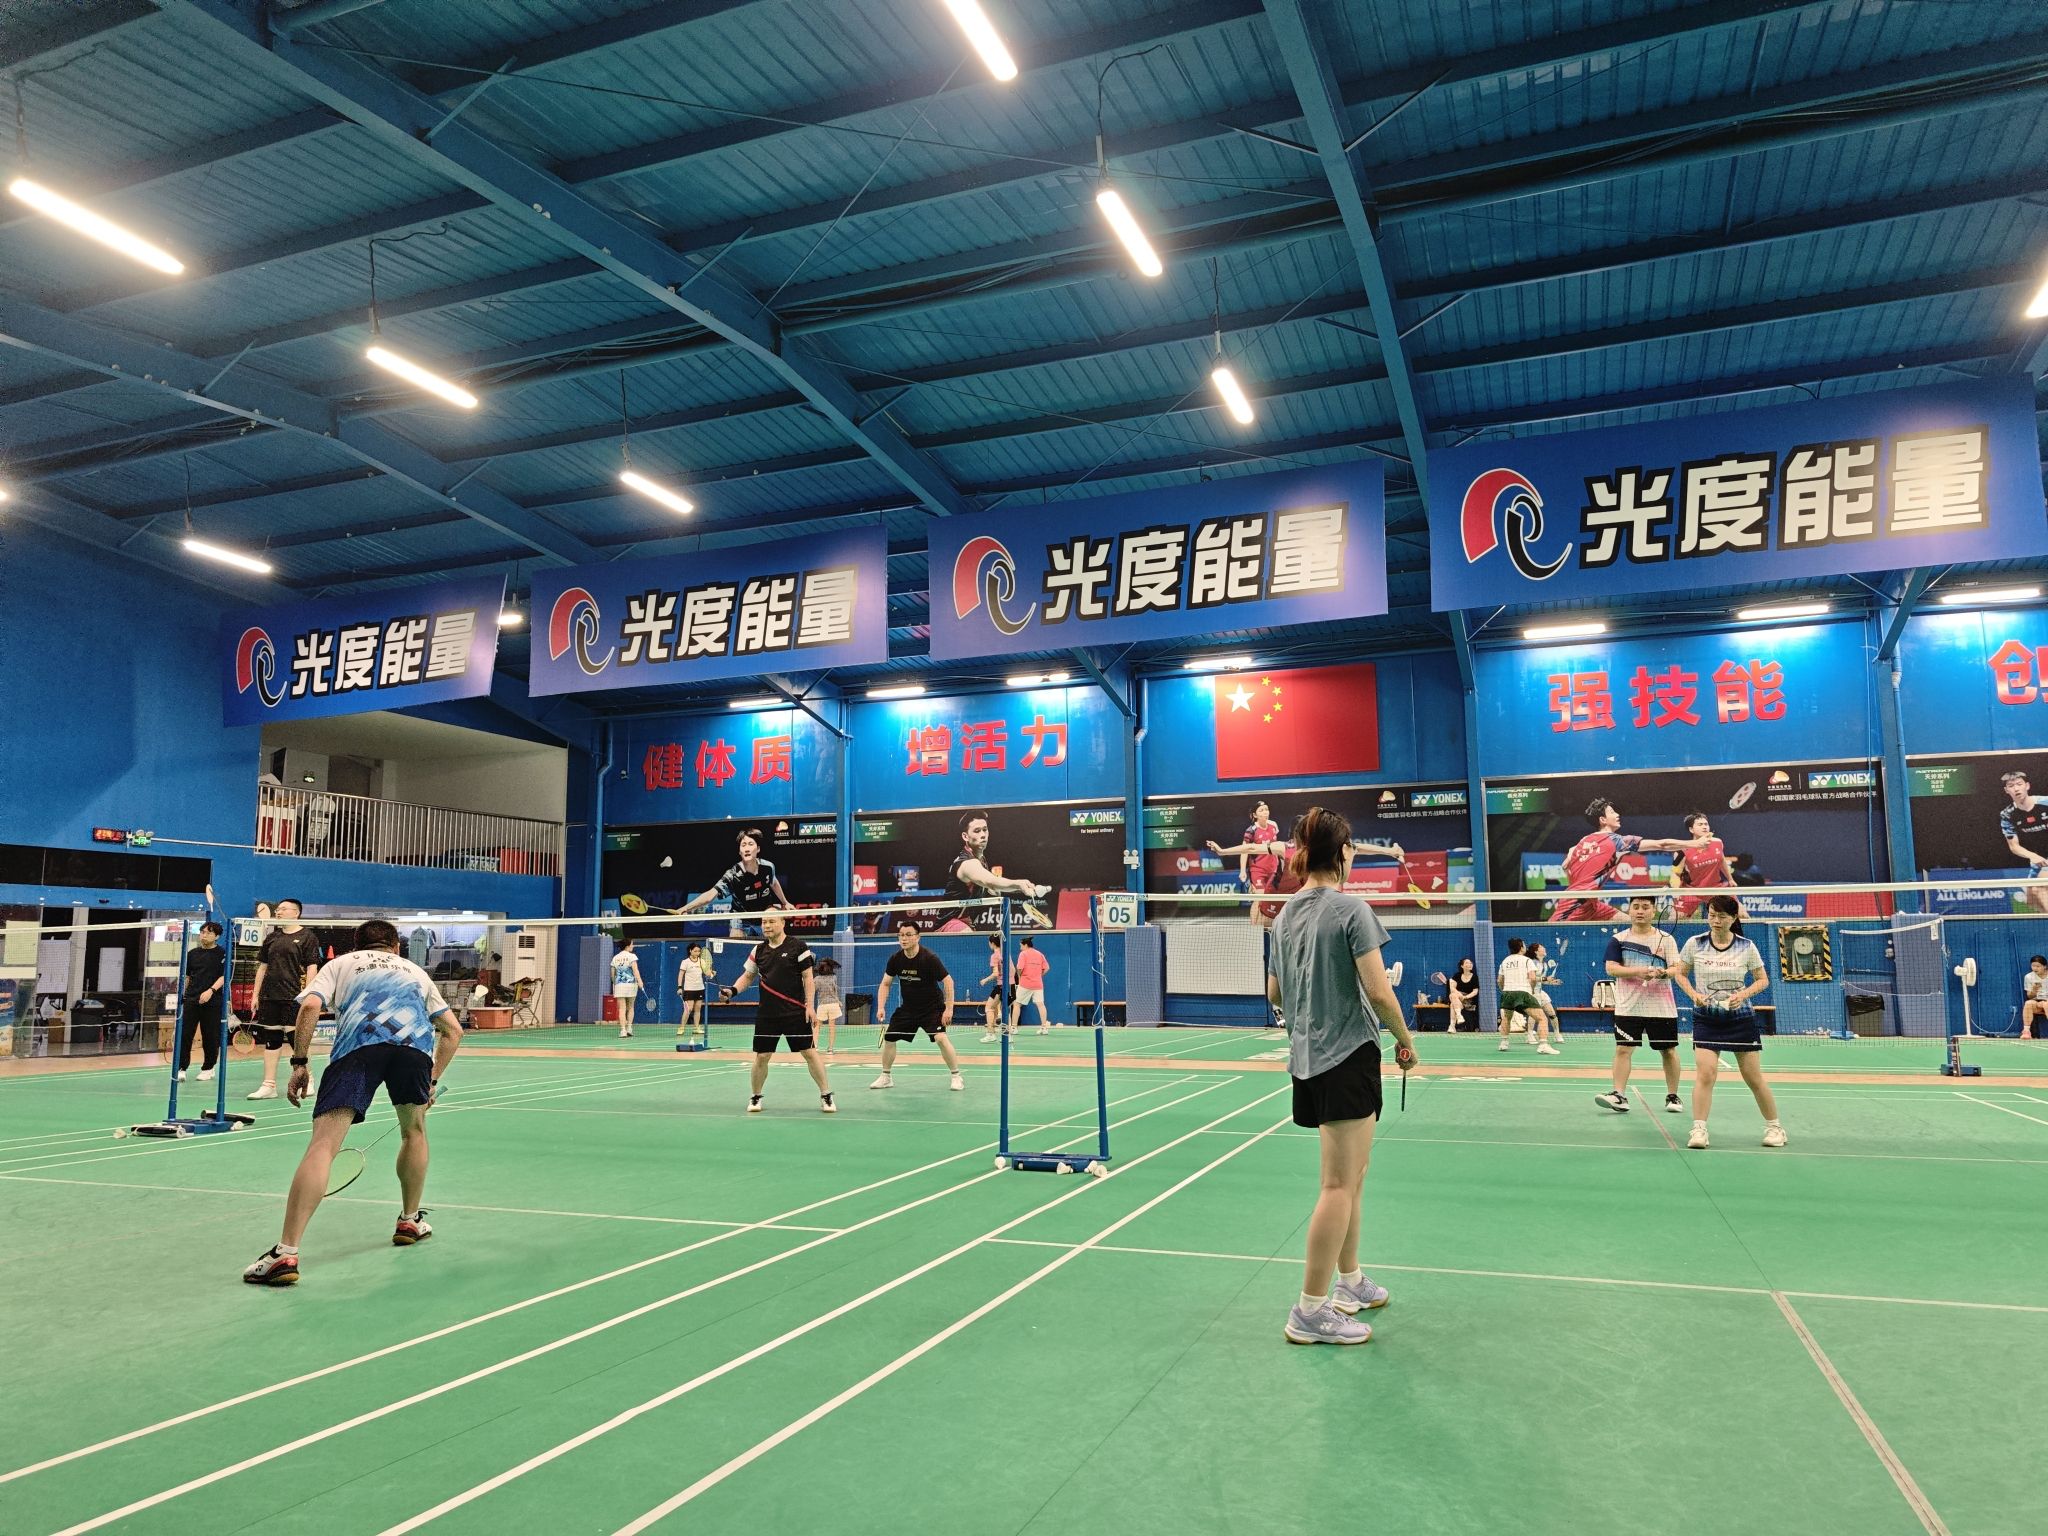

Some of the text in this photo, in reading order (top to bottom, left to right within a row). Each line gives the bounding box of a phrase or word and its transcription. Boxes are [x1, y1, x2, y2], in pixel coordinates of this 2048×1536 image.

[1583, 429, 1986, 566] 光度能量
[1043, 504, 1346, 622] 光度能量
[619, 567, 857, 664] 光度能量
[291, 611, 476, 697] 光度能量
[1547, 658, 1787, 733] 强技能
[905, 714, 1068, 776] 增活力
[642, 735, 792, 791] 健体质
[1834, 774, 1871, 785] YONEX
[1432, 792, 1463, 804] YONEX
[1091, 811, 1121, 823] YONEX
[814, 824, 836, 833] YONEX
[1200, 883, 1237, 894] YONEX
[1936, 891, 1956, 901] ALL
[1957, 889, 2005, 900] ENGLAND
[1109, 906, 1131, 923] 05
[244, 929, 259, 942] 06
